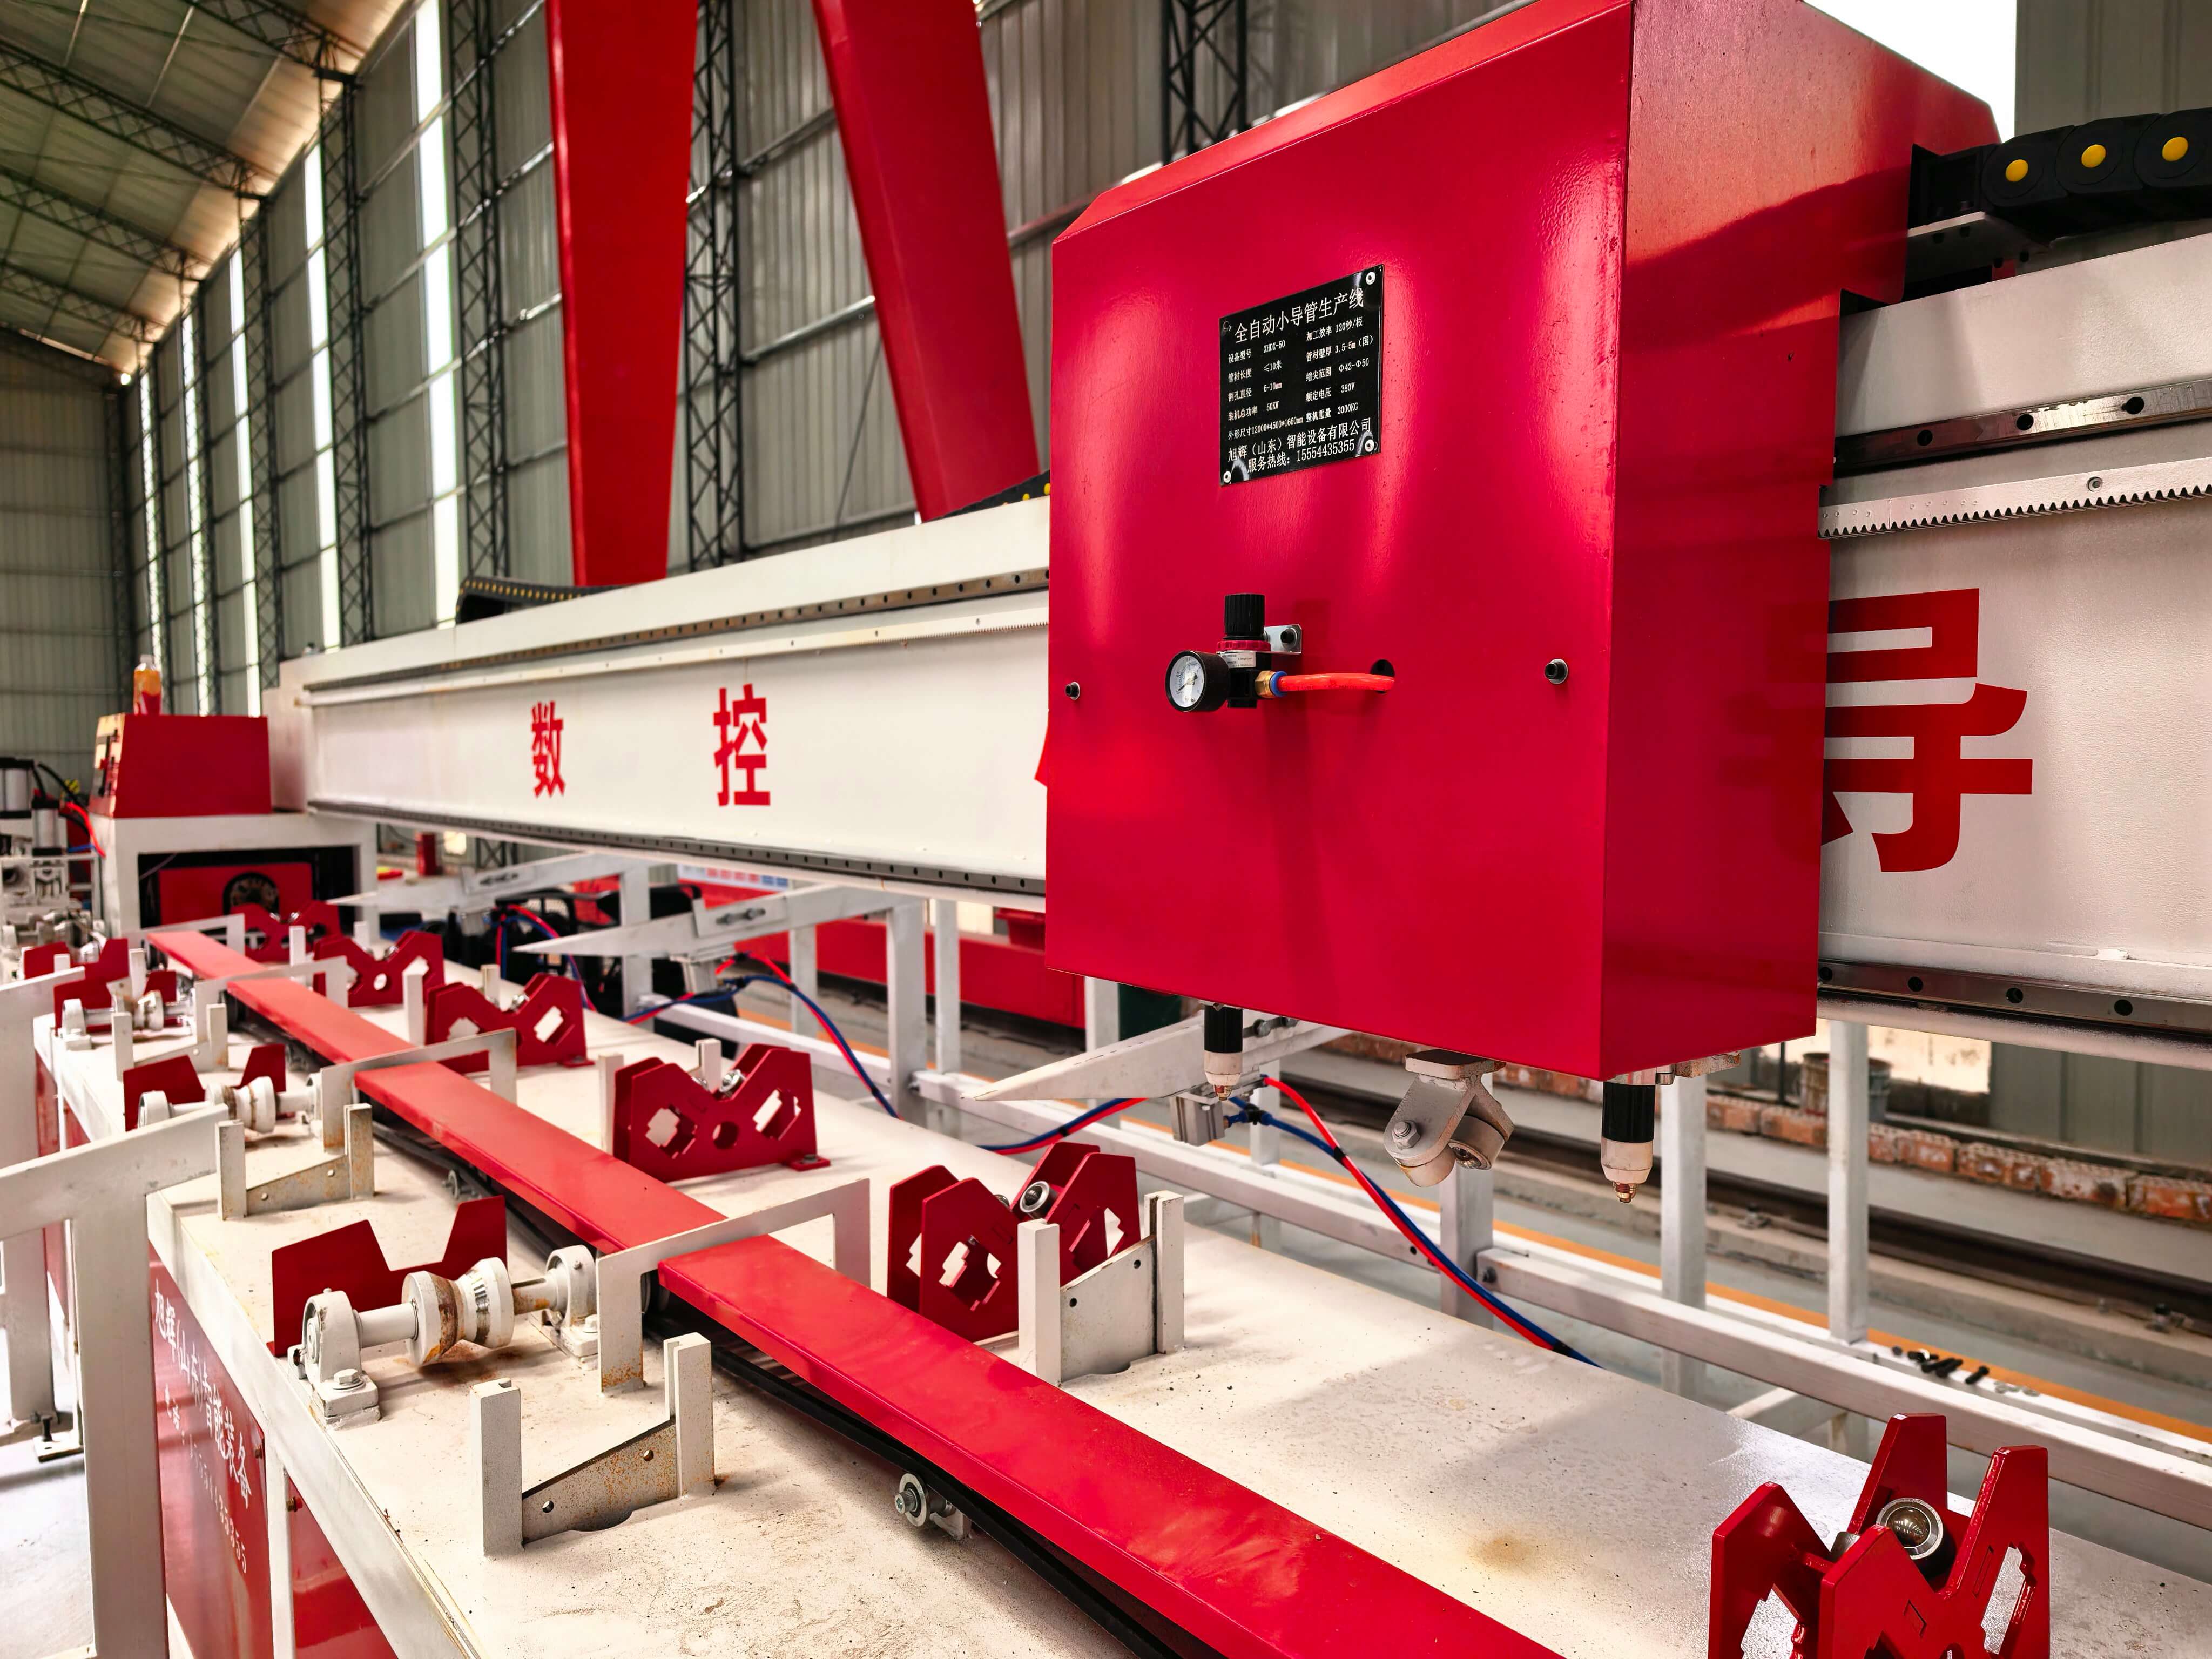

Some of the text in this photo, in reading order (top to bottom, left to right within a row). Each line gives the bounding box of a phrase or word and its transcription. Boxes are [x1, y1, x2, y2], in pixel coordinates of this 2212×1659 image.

[1235, 287, 1364, 343] 全自动小导管生产线
[1306, 316, 1363, 341] 加工效率 120秒/根
[1228, 340, 1285, 363] 设备型号 XHDX-50
[1306, 346, 1332, 362] 管材壁厚
[1228, 360, 1282, 383] 管材长度 ≤10米
[1264, 382, 1282, 392] 6-10mm
[1306, 382, 1355, 402] 额定电压 380V
[1228, 401, 1279, 421] 装机总功率 50KW
[1306, 402, 1358, 422] 整机重量 3000KG
[1228, 417, 1371, 463] 旭辉（山东）智能设备有限公司
